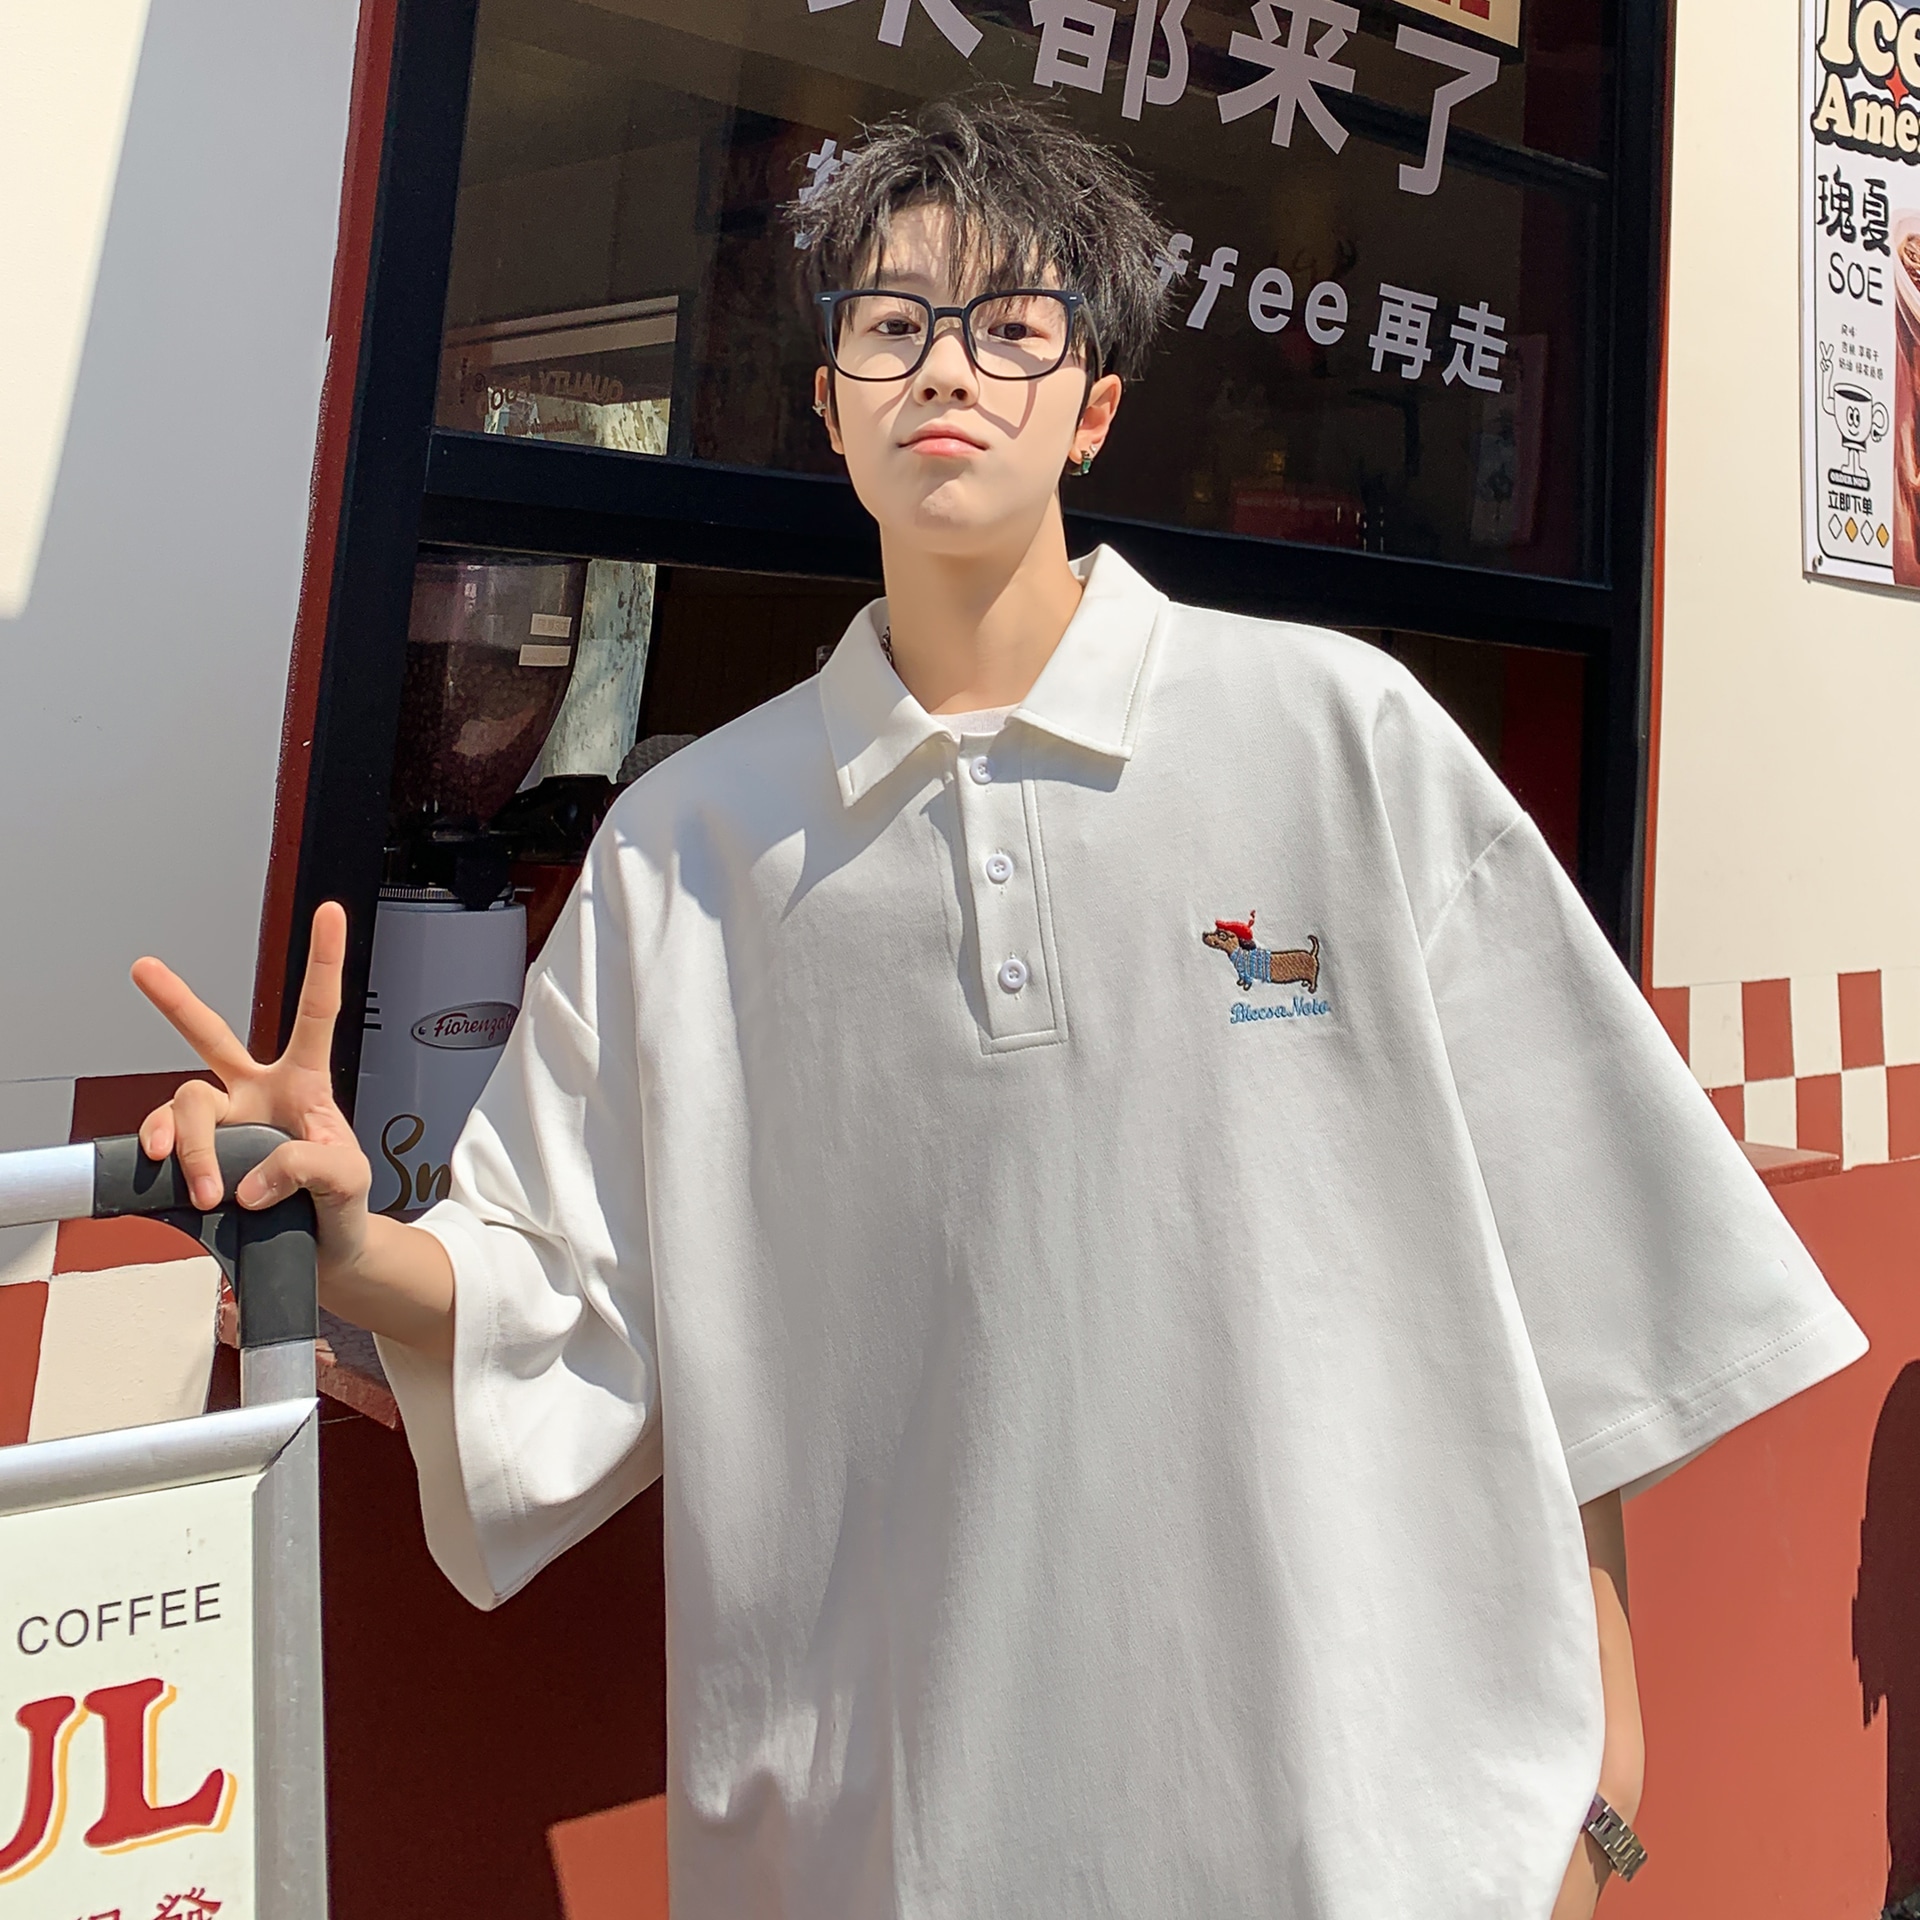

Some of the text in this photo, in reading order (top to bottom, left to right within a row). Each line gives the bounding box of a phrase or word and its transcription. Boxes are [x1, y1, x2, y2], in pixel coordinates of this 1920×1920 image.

[1812, 71, 1920, 164] Ame
[1816, 164, 1891, 257] 瑰夏
[1154, 233, 1508, 393] ffee 再走
[1828, 252, 1883, 306] SOE
[1828, 490, 1873, 517] 立即下单
[434, 1012, 515, 1041] Fiorenzat
[17, 1583, 221, 1655] COFFEE
